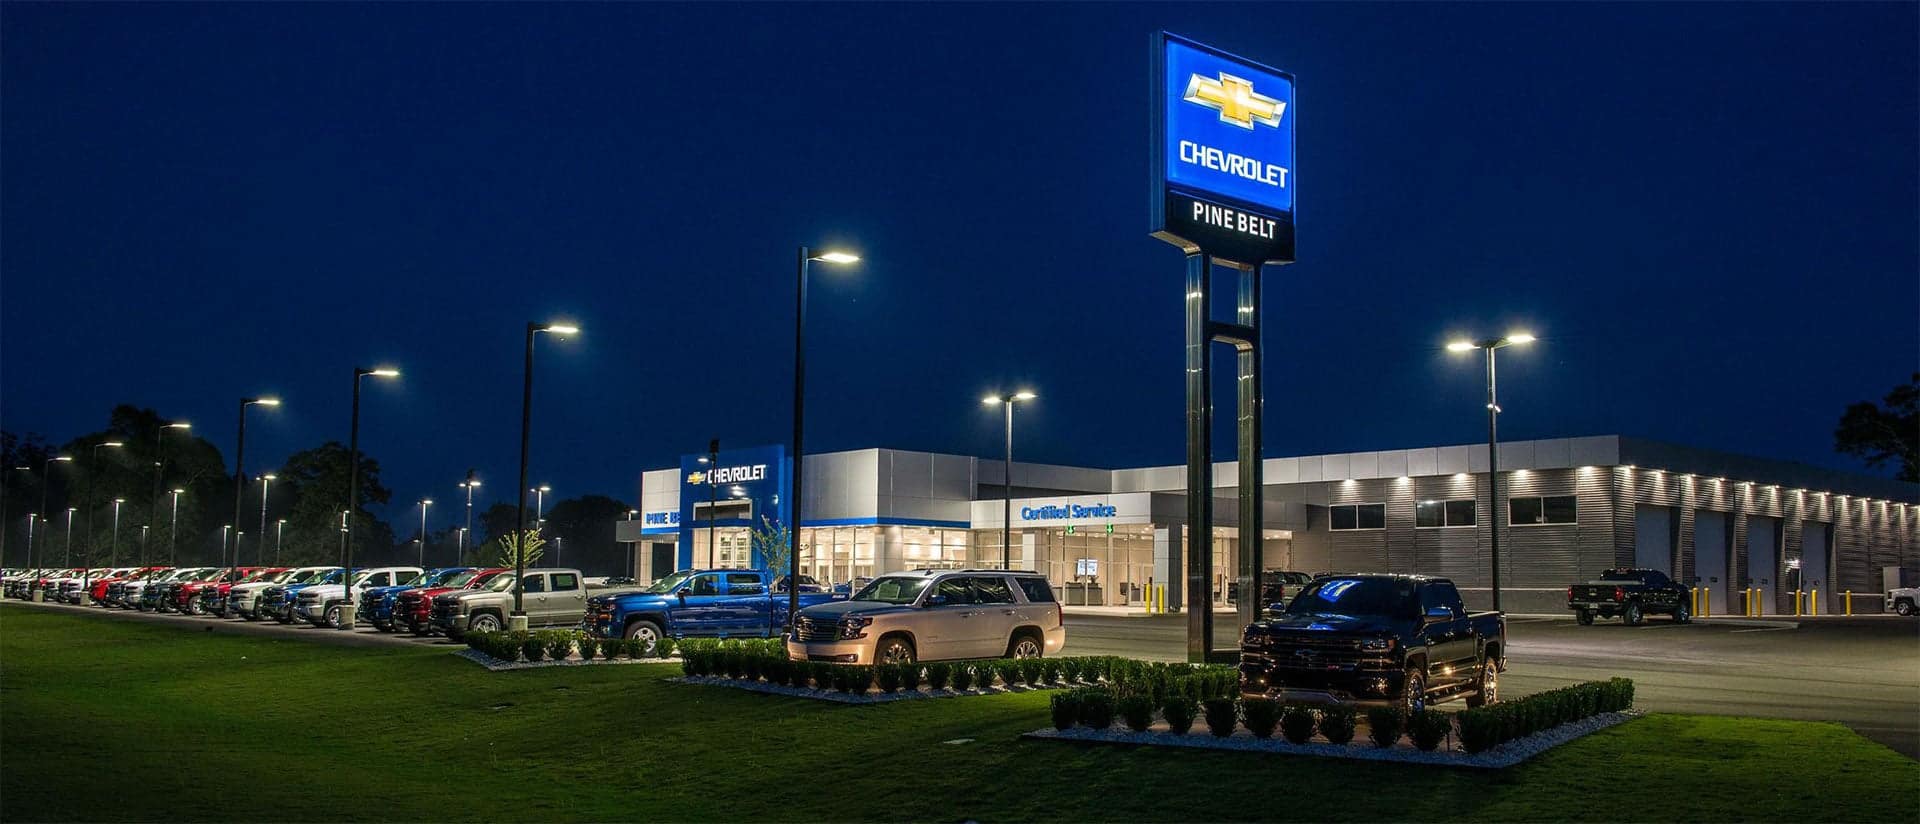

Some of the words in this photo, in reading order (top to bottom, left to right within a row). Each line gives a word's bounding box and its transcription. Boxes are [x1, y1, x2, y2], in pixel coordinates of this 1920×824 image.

[1179, 140, 1288, 188] CHEVROLET
[1193, 201, 1234, 229] PINE
[1237, 212, 1276, 239] BELT
[707, 464, 767, 484] CHEVROLET
[646, 512, 668, 525] PINE
[1021, 504, 1070, 520] Certified
[1071, 503, 1116, 518] Service
